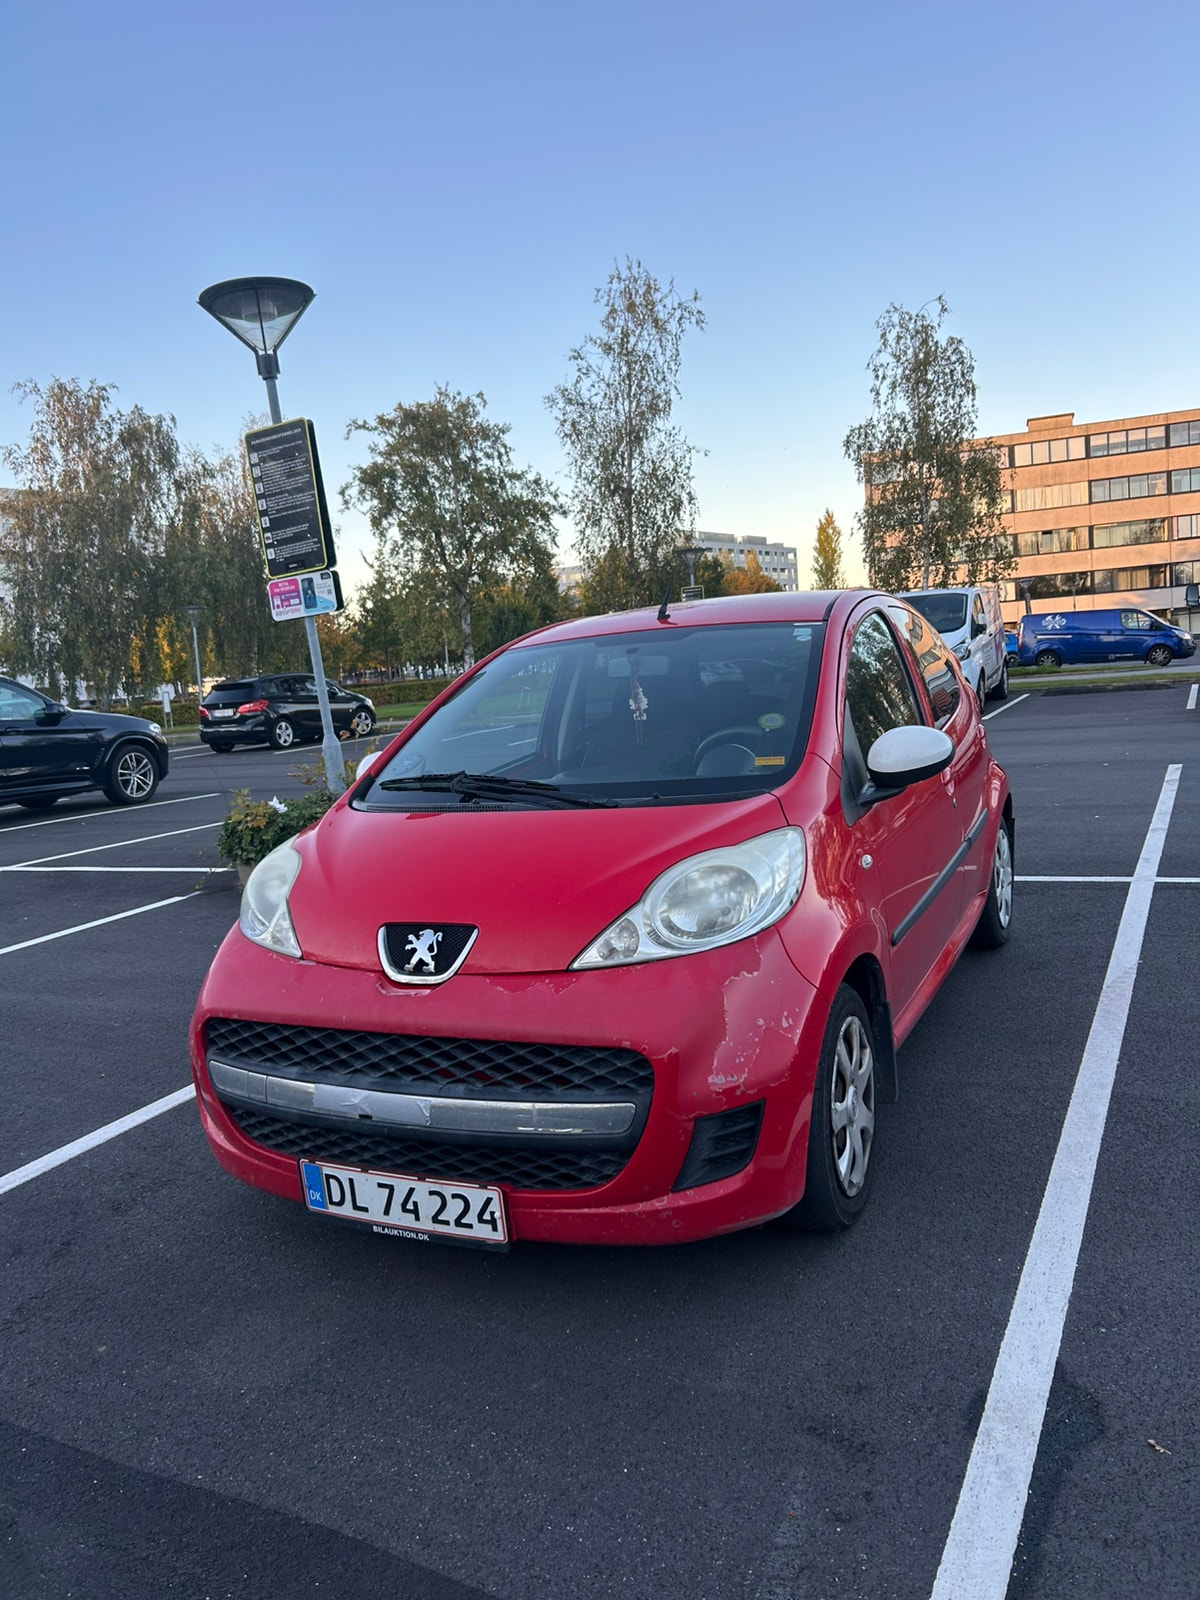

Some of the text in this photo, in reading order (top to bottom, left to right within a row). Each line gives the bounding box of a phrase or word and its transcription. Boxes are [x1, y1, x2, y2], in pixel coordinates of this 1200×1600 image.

[309, 1190, 322, 1202] DK
[325, 1173, 499, 1232] DL 74 224
[373, 1225, 430, 1241] BILAUKTION.DK
